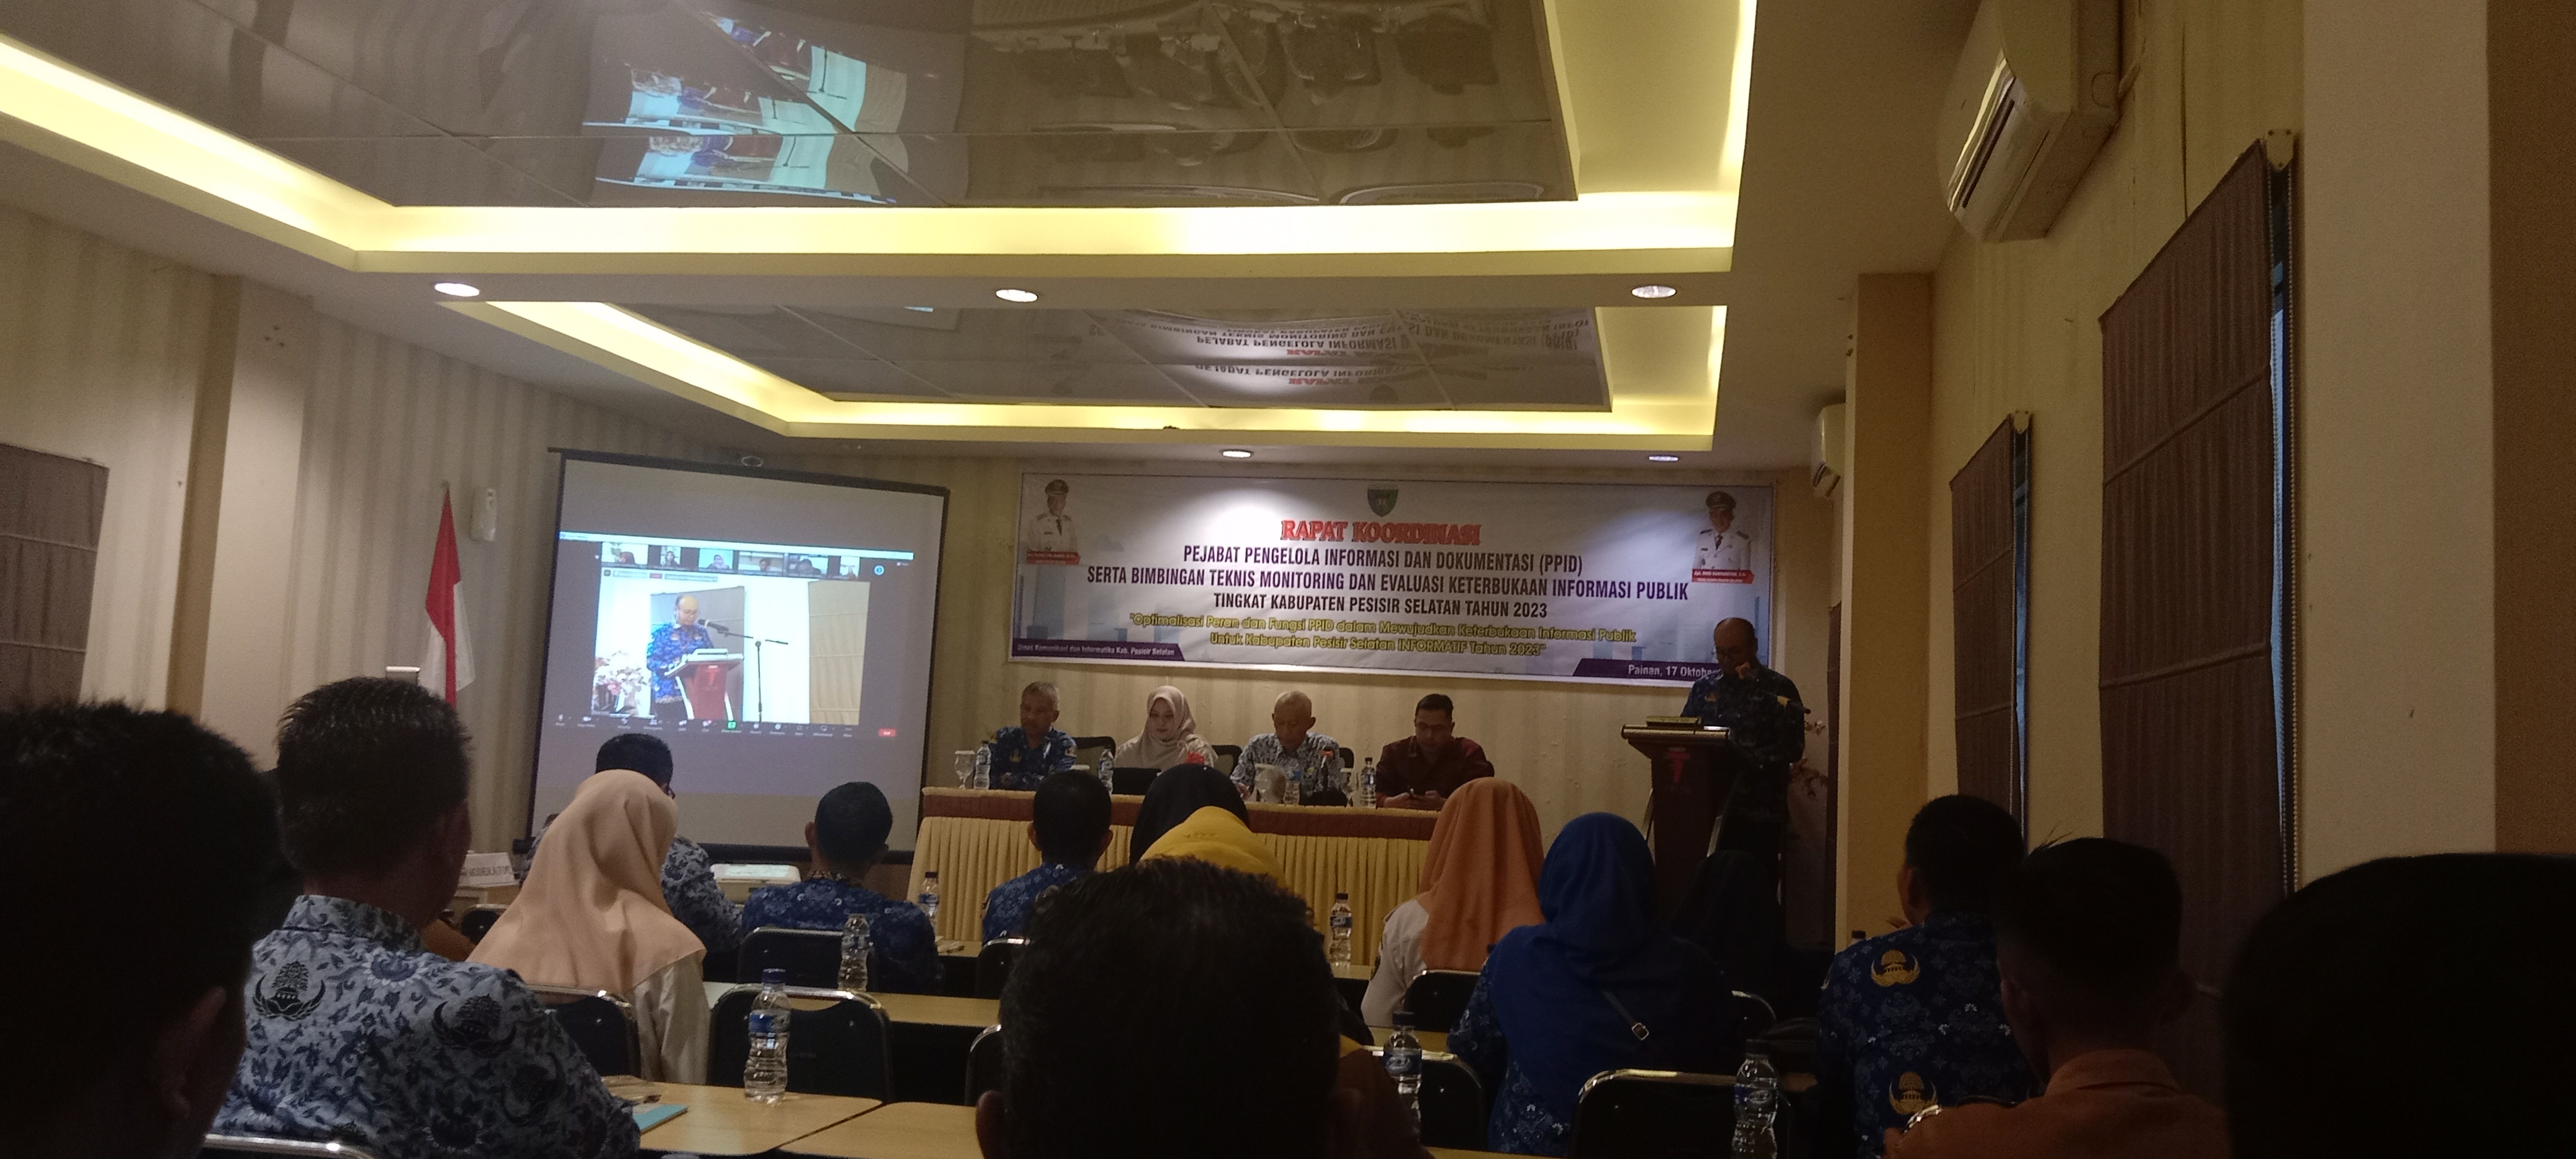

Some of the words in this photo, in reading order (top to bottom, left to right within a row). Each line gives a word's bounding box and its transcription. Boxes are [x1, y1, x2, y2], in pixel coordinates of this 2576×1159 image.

[1281, 520, 1348, 542] RAPAT
[1352, 522, 1481, 545] KOORDINASI
[1184, 545, 1240, 563] PEJABAT
[1245, 547, 1320, 565] PENGELOLA
[1325, 549, 1399, 568] INFORMASI
[1404, 550, 1431, 568] DAN
[1436, 552, 1534, 571] DOKUMENTASI
[1539, 555, 1582, 576] (PPID)
[1087, 566, 1126, 583] SERTA
[1131, 568, 1204, 586] BIMBINGAN
[1210, 570, 1255, 587] TEKNIS
[1260, 571, 1344, 589] MONITORING
[1349, 573, 1375, 591] DAN
[1381, 575, 1443, 593] EVALUASI
[1449, 576, 1547, 596] KETERBUKAAN
[1552, 580, 1631, 599] INFORMASI
[1637, 581, 1689, 600] PUBLIK
[1214, 593, 1266, 609] TINGKAT
[1271, 594, 1345, 612] KABUPATEN
[1349, 597, 1400, 613] PESISIR
[1404, 599, 1461, 615] SELATAN
[1465, 601, 1508, 617] TAHUN
[1513, 602, 1547, 618] 2023
[1130, 613, 1204, 627] "Optimalisasi
[1207, 615, 1239, 628] Peran
[1242, 617, 1266, 629] dan
[1268, 618, 1305, 632] Fungsi
[1308, 619, 1334, 631] PPID
[1336, 620, 1376, 633] dalam
[1378, 622, 1455, 636] Mewujudkan
[1458, 623, 1536, 639] Keterbukaan
[1538, 627, 1596, 641] Informasi
[1598, 628, 1637, 642] Publik
[1131, 647, 1151, 655] Pesisir
[1152, 648, 1175, 656] Selatan
[1210, 633, 1242, 645] Untuk
[1245, 634, 1310, 648] Kabupaten
[1313, 636, 1348, 649] Pesisir
[1349, 637, 1395, 651] Selatan
[1398, 639, 1468, 653] INFORMATIF
[1470, 641, 1507, 654] Tahun
[1509, 643, 1546, 656] 2023"
[1628, 664, 1663, 677] Painan,
[1666, 666, 1678, 676] 17
